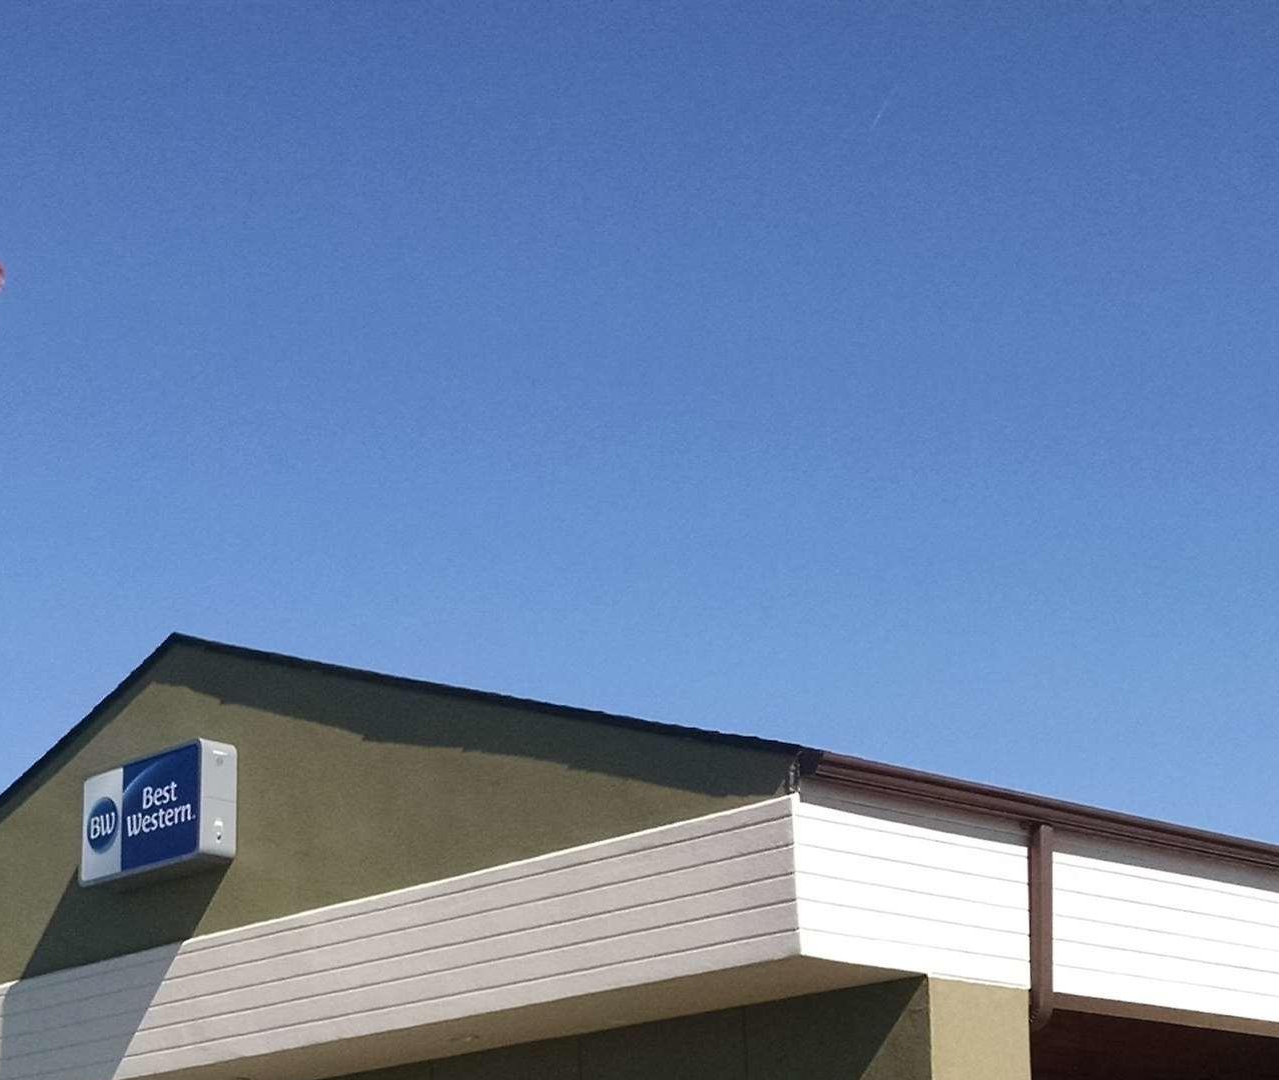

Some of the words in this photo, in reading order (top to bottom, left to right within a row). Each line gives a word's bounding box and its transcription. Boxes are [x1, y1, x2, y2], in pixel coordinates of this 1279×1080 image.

[142, 781, 178, 809] Best
[90, 812, 116, 839] BW
[126, 804, 193, 837] Western
